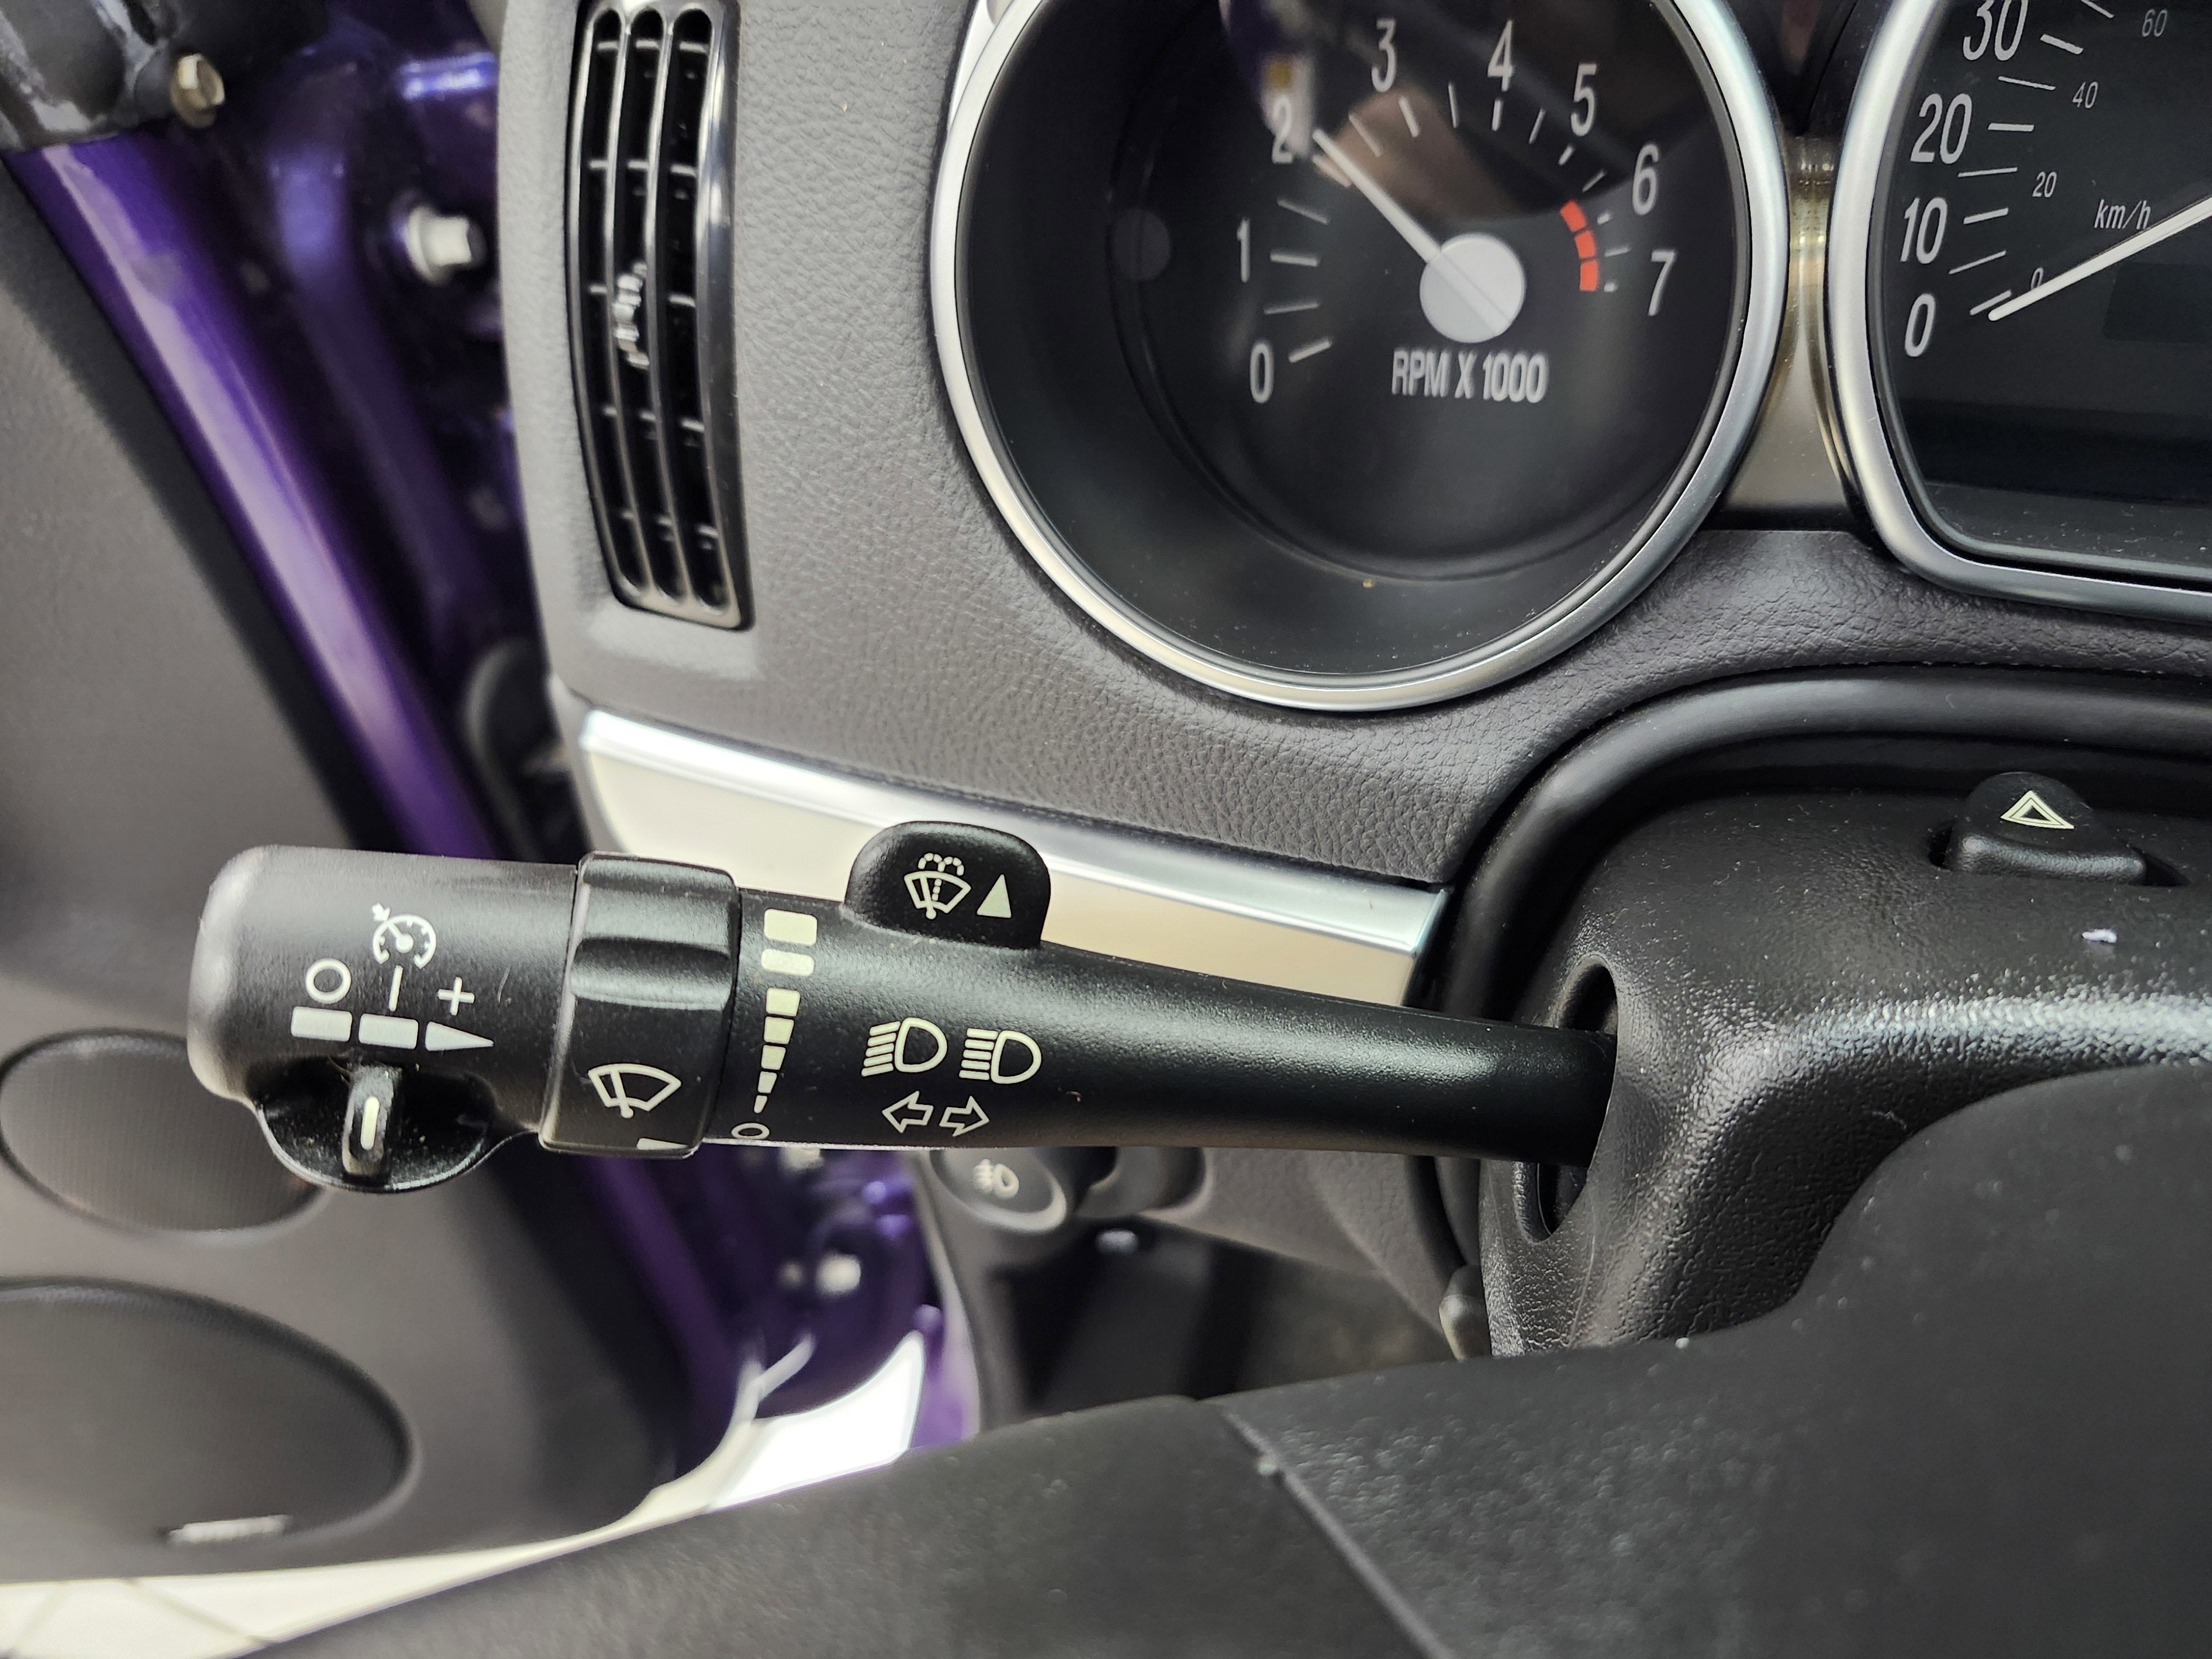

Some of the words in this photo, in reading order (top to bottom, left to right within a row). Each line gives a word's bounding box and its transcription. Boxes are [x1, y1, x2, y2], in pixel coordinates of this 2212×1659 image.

[1370, 18, 1398, 93] 3
[1487, 19, 1515, 92] 4
[1962, 0, 2030, 61] 30
[2141, 9, 2168, 38] 60
[1570, 62, 1598, 137] 5
[1910, 92, 1973, 164] 20
[2072, 81, 2099, 109] 40
[1272, 97, 1294, 164] 2
[1631, 143, 1660, 216] 6
[2032, 171, 2058, 198] 20
[1900, 196, 1948, 264] 10
[2094, 200, 2151, 230] km/h
[1237, 217, 1251, 283] 1
[1647, 248, 1677, 316] 7
[1904, 293, 1937, 357] 0
[1249, 342, 1274, 404] 0
[1391, 349, 1451, 397] RPM
[1454, 350, 1475, 399] X
[1482, 349, 1548, 404] 1000
